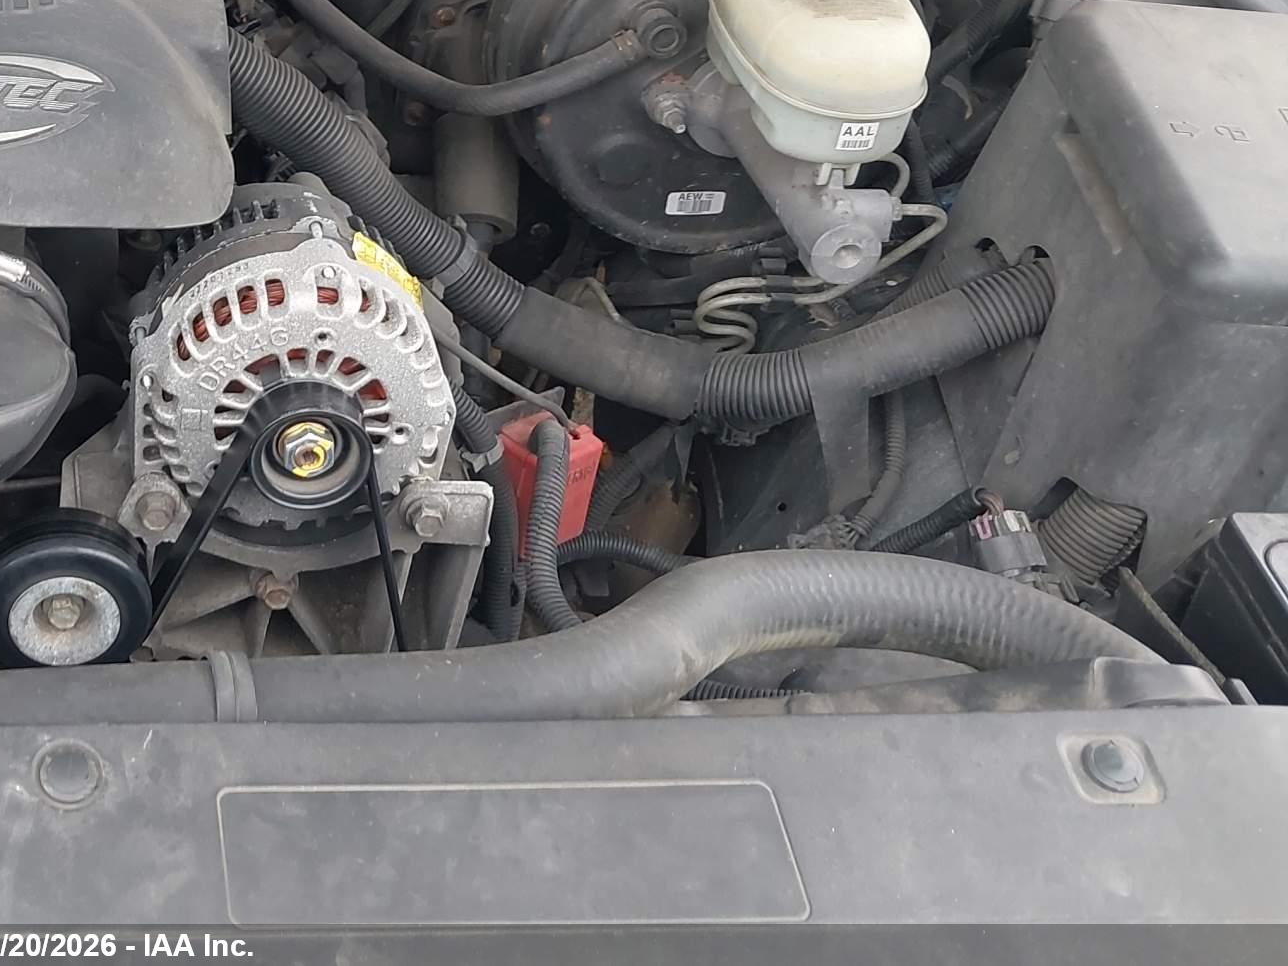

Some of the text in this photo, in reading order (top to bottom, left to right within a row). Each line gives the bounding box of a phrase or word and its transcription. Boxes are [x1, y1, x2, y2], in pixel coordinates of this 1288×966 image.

[842, 125, 875, 137] AAL
[678, 192, 704, 201] AEW
[197, 327, 289, 392] DR44G
